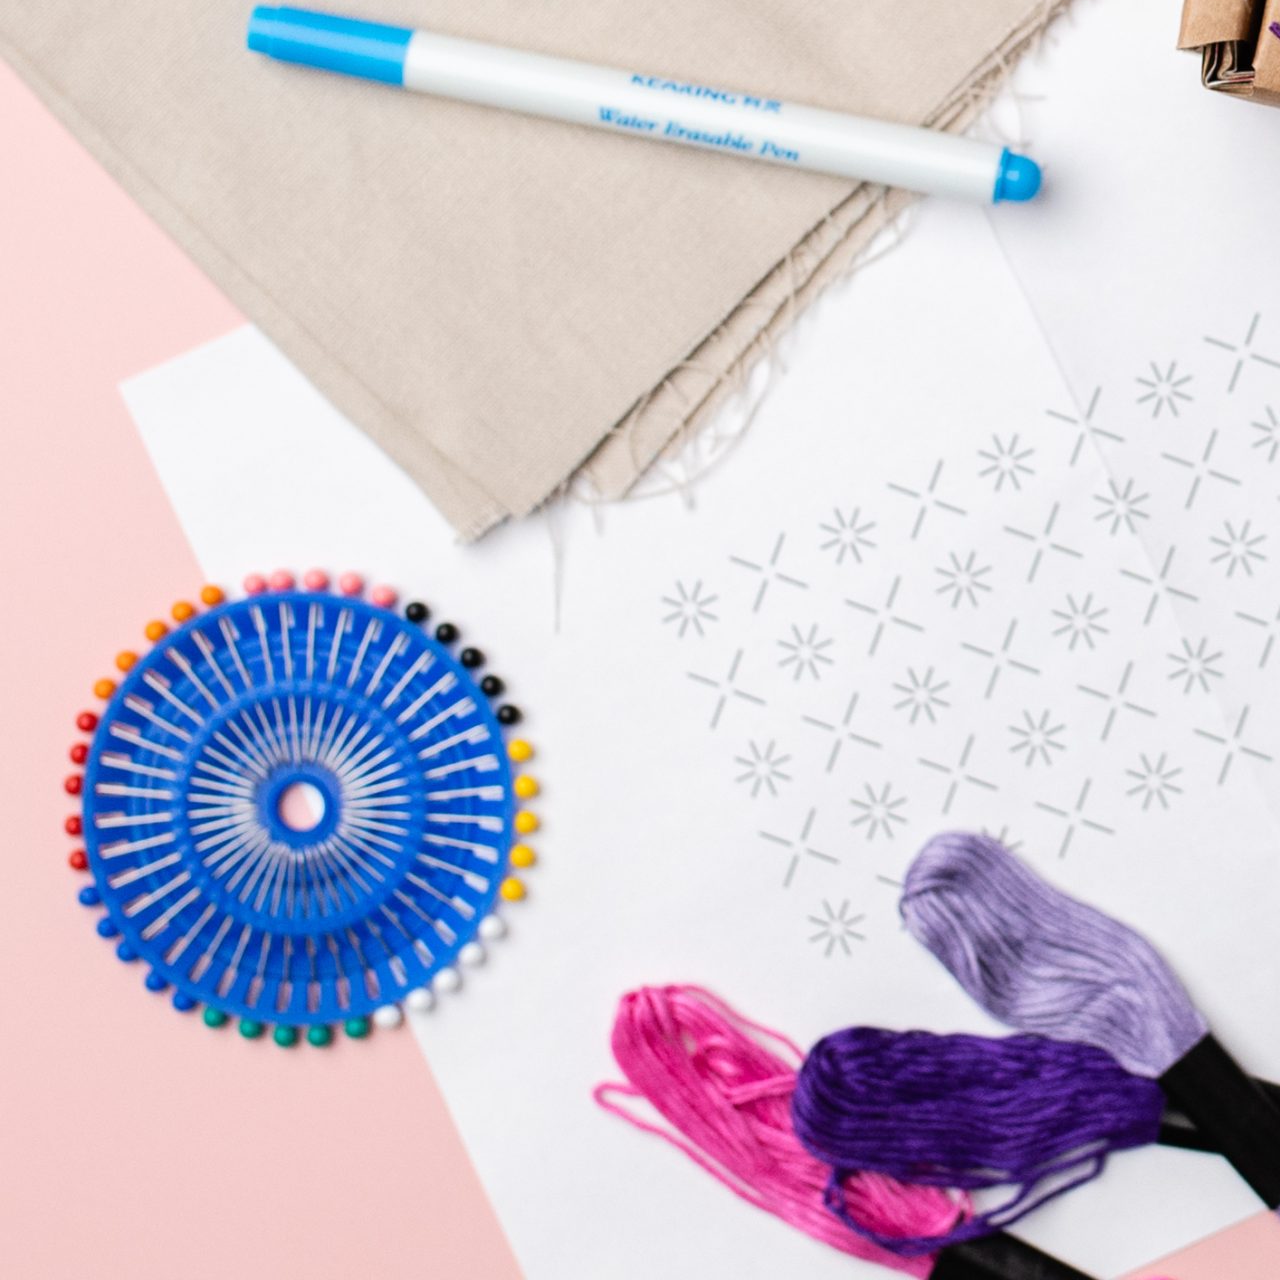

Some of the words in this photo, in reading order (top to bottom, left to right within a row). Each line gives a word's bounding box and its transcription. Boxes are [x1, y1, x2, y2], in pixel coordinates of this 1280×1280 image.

[598, 106, 657, 132] Water
[663, 121, 755, 152] Erasable
[758, 140, 800, 162] Pen
